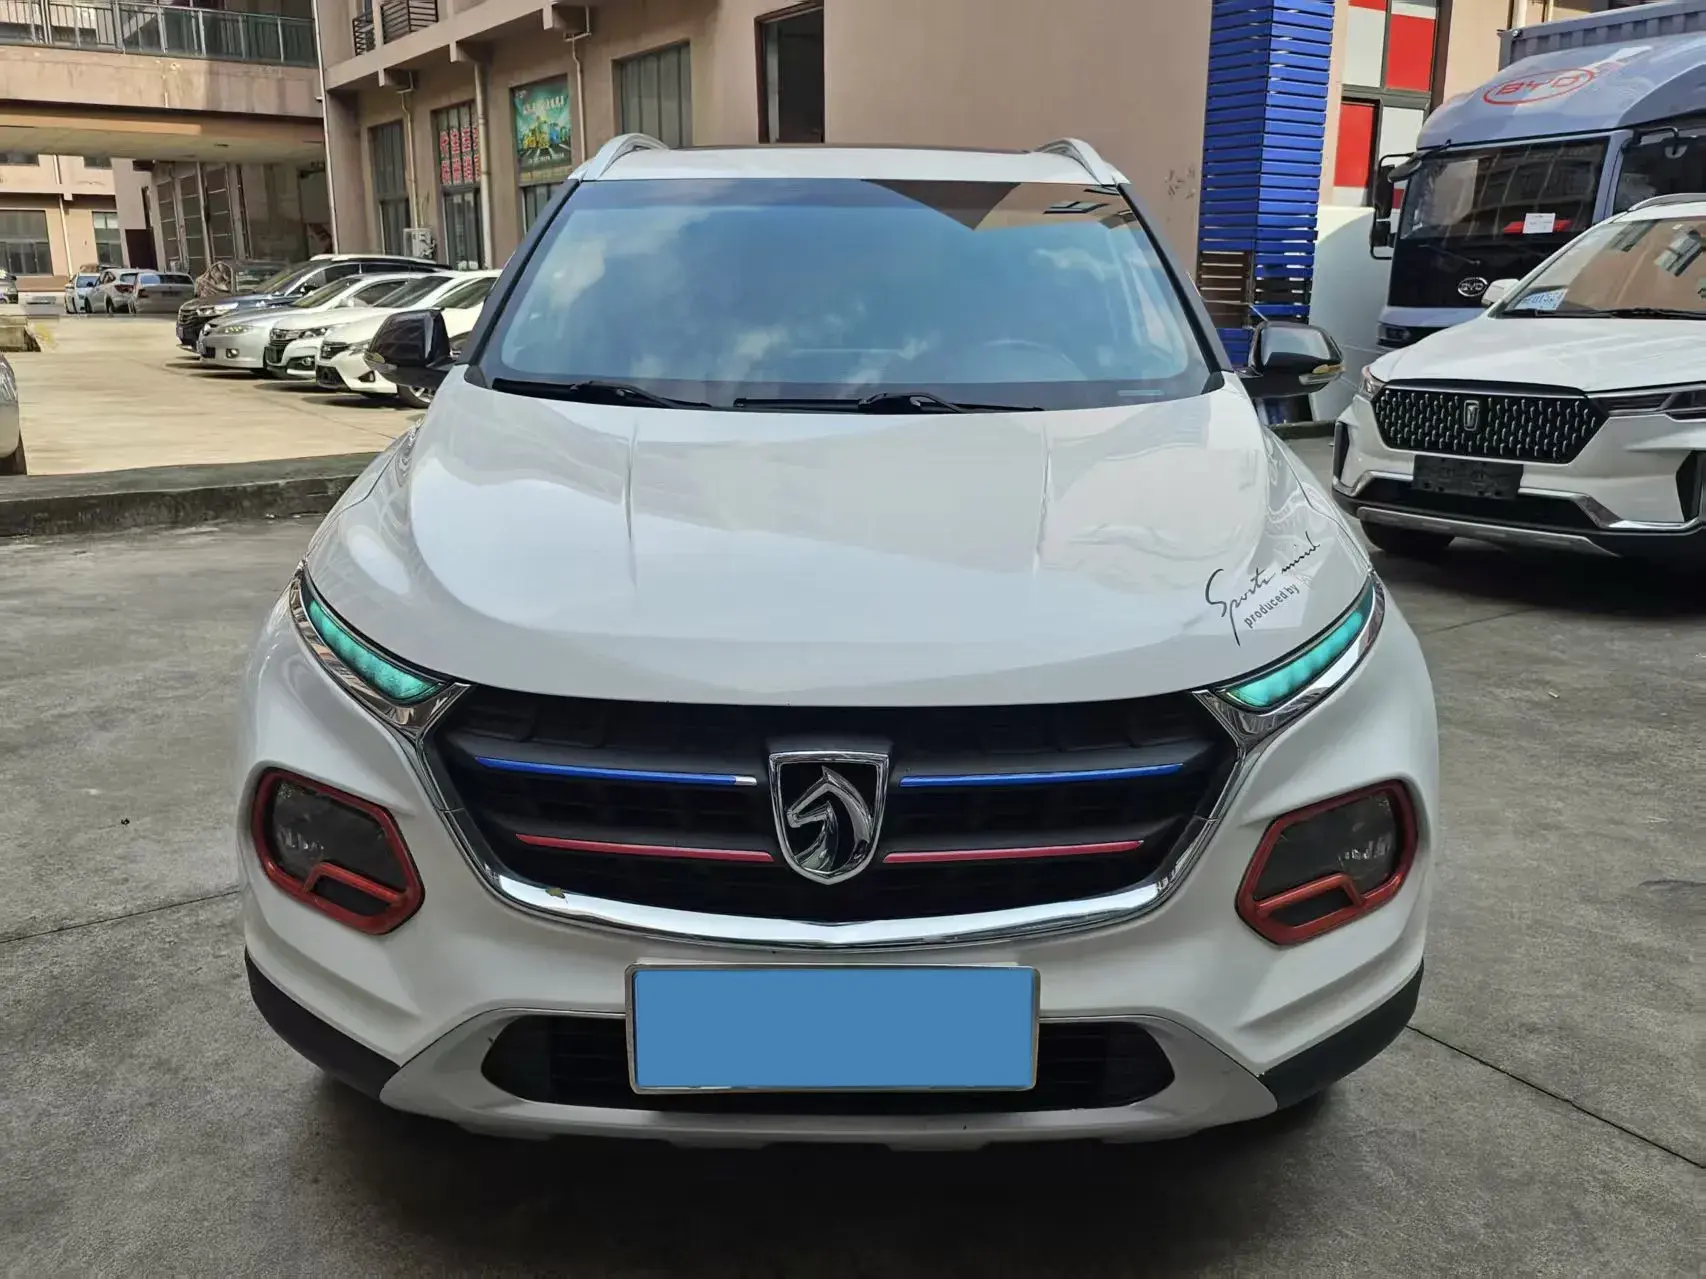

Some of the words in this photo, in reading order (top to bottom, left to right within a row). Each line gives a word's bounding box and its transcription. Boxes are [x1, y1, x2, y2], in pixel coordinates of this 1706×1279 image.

[1496, 75, 1580, 95] BYD
[1244, 590, 1288, 628] produced
[1284, 583, 1300, 596] by
